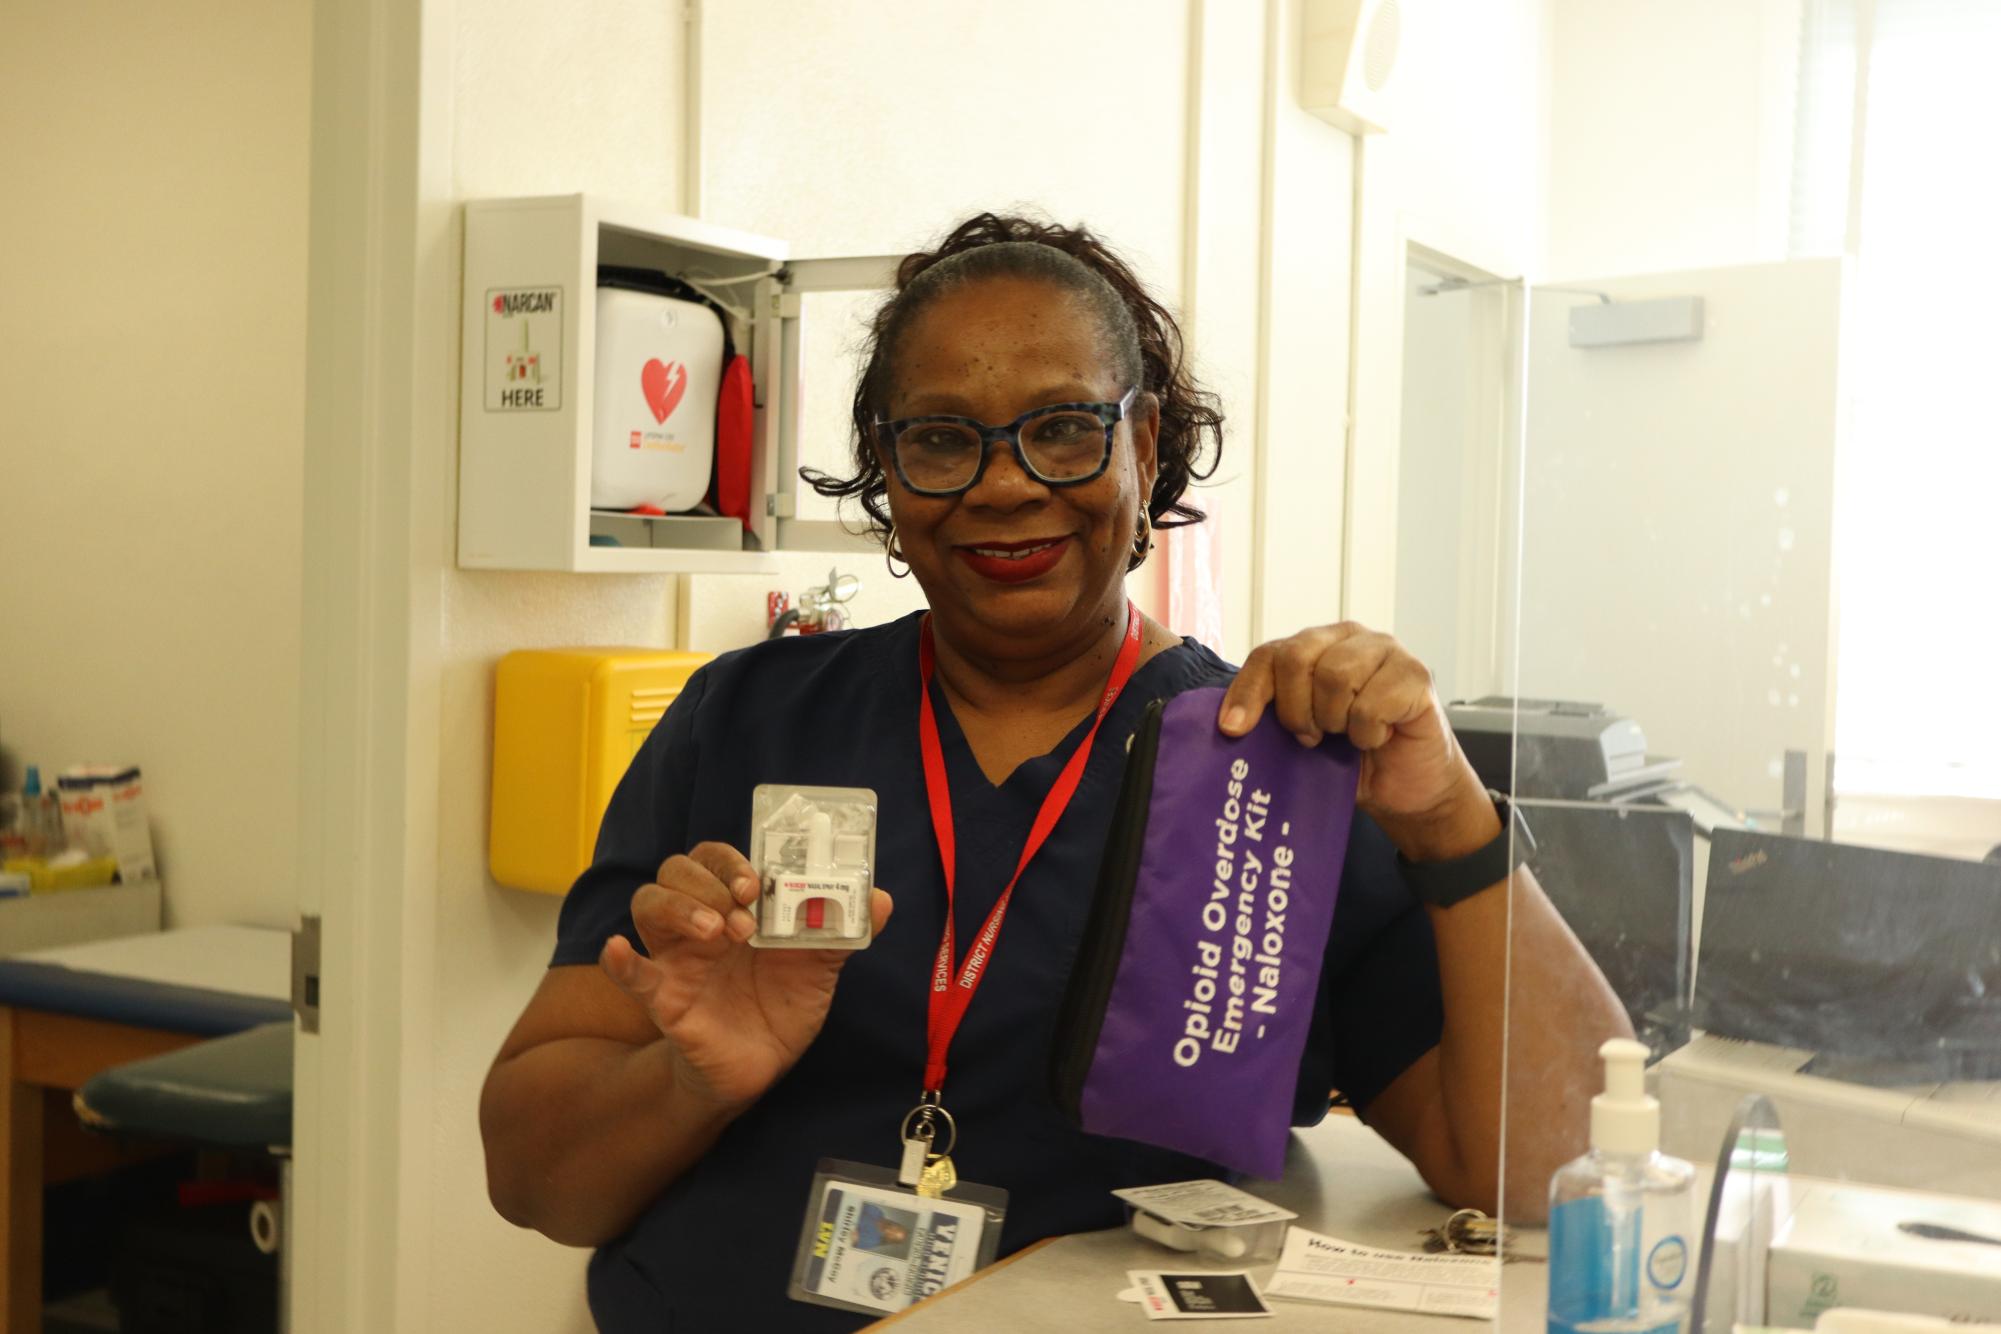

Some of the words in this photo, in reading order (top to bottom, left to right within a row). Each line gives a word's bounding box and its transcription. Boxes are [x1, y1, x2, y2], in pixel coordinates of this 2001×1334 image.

[503, 292, 553, 313] NARCAN
[502, 389, 544, 407] HERE
[1173, 940, 1222, 1067] Opioid
[1202, 758, 1249, 932] Overdose
[1211, 850, 1263, 1054] Emergency
[1244, 788, 1271, 842] Kit
[1251, 845, 1294, 1015] Naloxone
[960, 942, 988, 989] DISTRICT
[814, 1222, 833, 1257] LVN
[920, 1224, 956, 1300] VENIC
[1308, 1238, 1346, 1253] How
